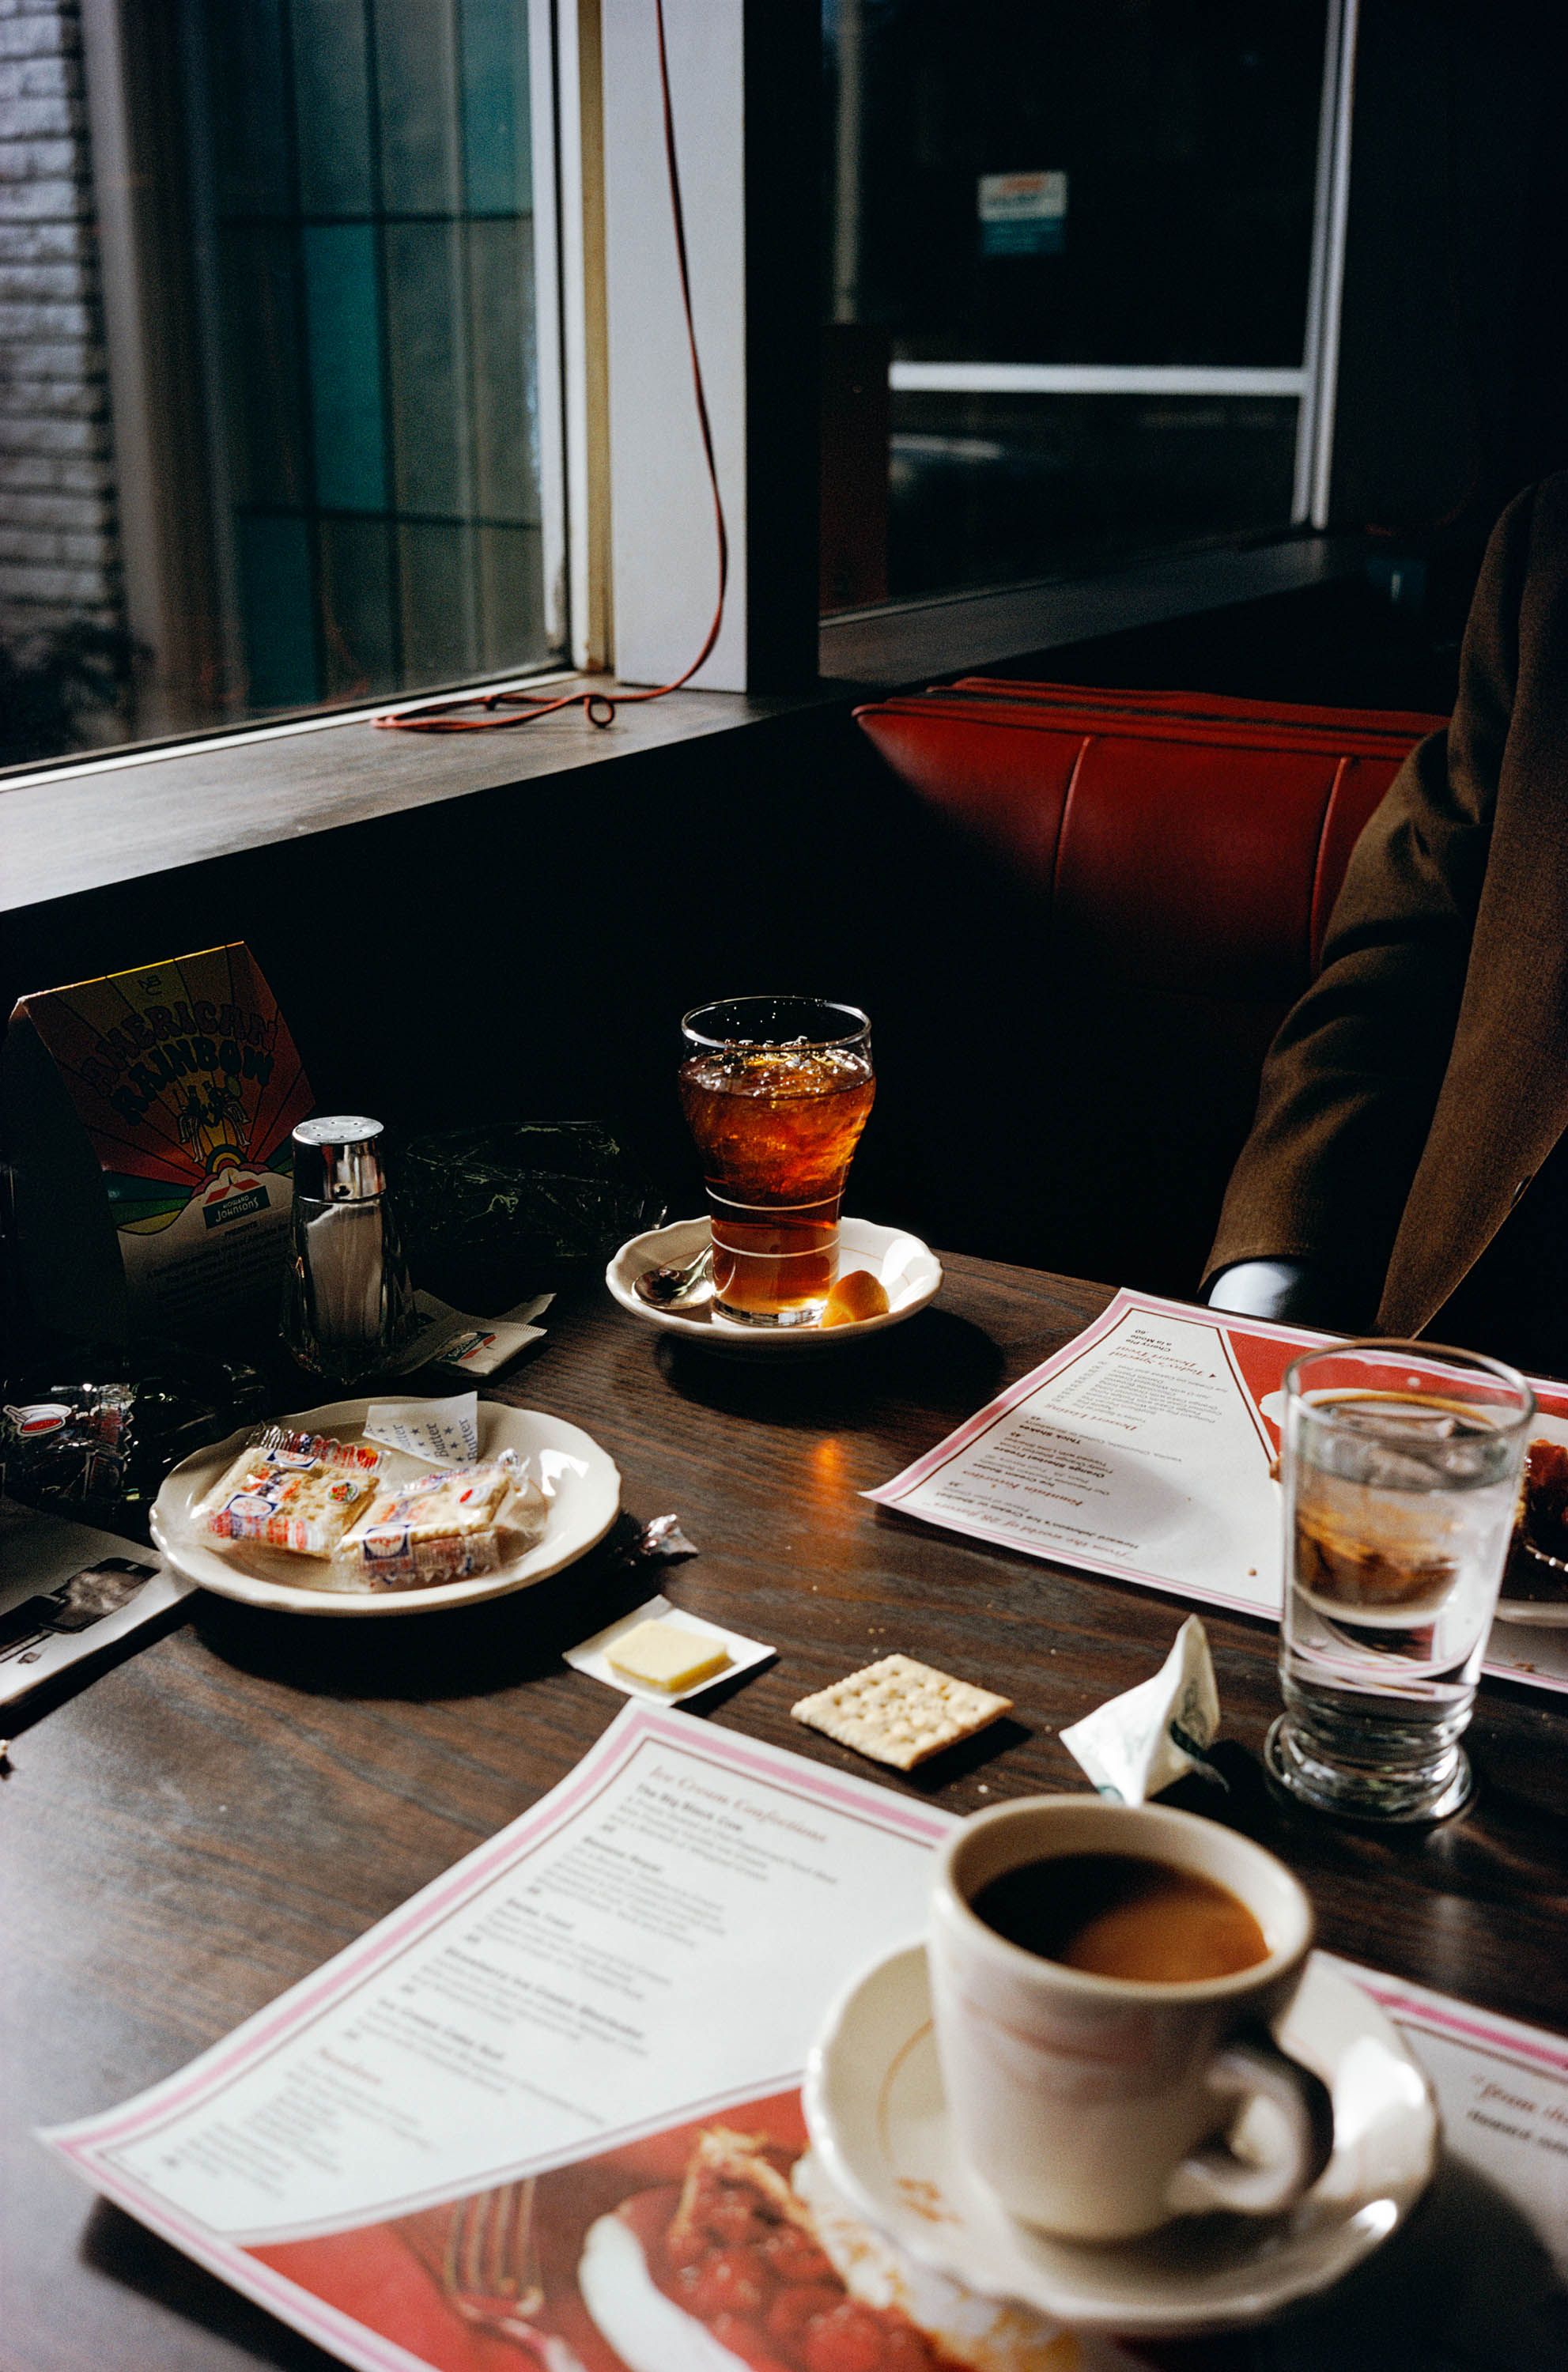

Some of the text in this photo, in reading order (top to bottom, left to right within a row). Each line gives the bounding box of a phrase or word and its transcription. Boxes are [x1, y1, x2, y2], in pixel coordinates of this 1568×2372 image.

[80, 1000, 279, 1099] AMERICAN
[110, 1035, 274, 1126] RAINBOW
[1108, 1350, 1152, 1365] Special
[1115, 1346, 1196, 1367] Dessert Treat
[1141, 1342, 1171, 1352] Cherry
[1044, 1403, 1138, 1431] Dessert Listing
[426, 1422, 450, 1458] Butter
[1018, 1424, 1081, 1445] Thick Shakes
[973, 1463, 1002, 1473] Sodas
[992, 1446, 1105, 1479] Orange Sherbet Freeze
[1055, 1456, 1086, 1467] Orange
[1004, 1471, 1037, 1482] Cream
[936, 1492, 975, 1504] Sherbet
[962, 1470, 1083, 1507] Fountain Favorites
[990, 1504, 1023, 1517] Cream
[1044, 1520, 1096, 1537] Johnson's
[1097, 1535, 1139, 1549] Howard
[648, 1765, 674, 1784] Ice
[677, 1777, 729, 1805] Cream
[637, 1783, 658, 1799] The
[659, 1792, 679, 1809] Big
